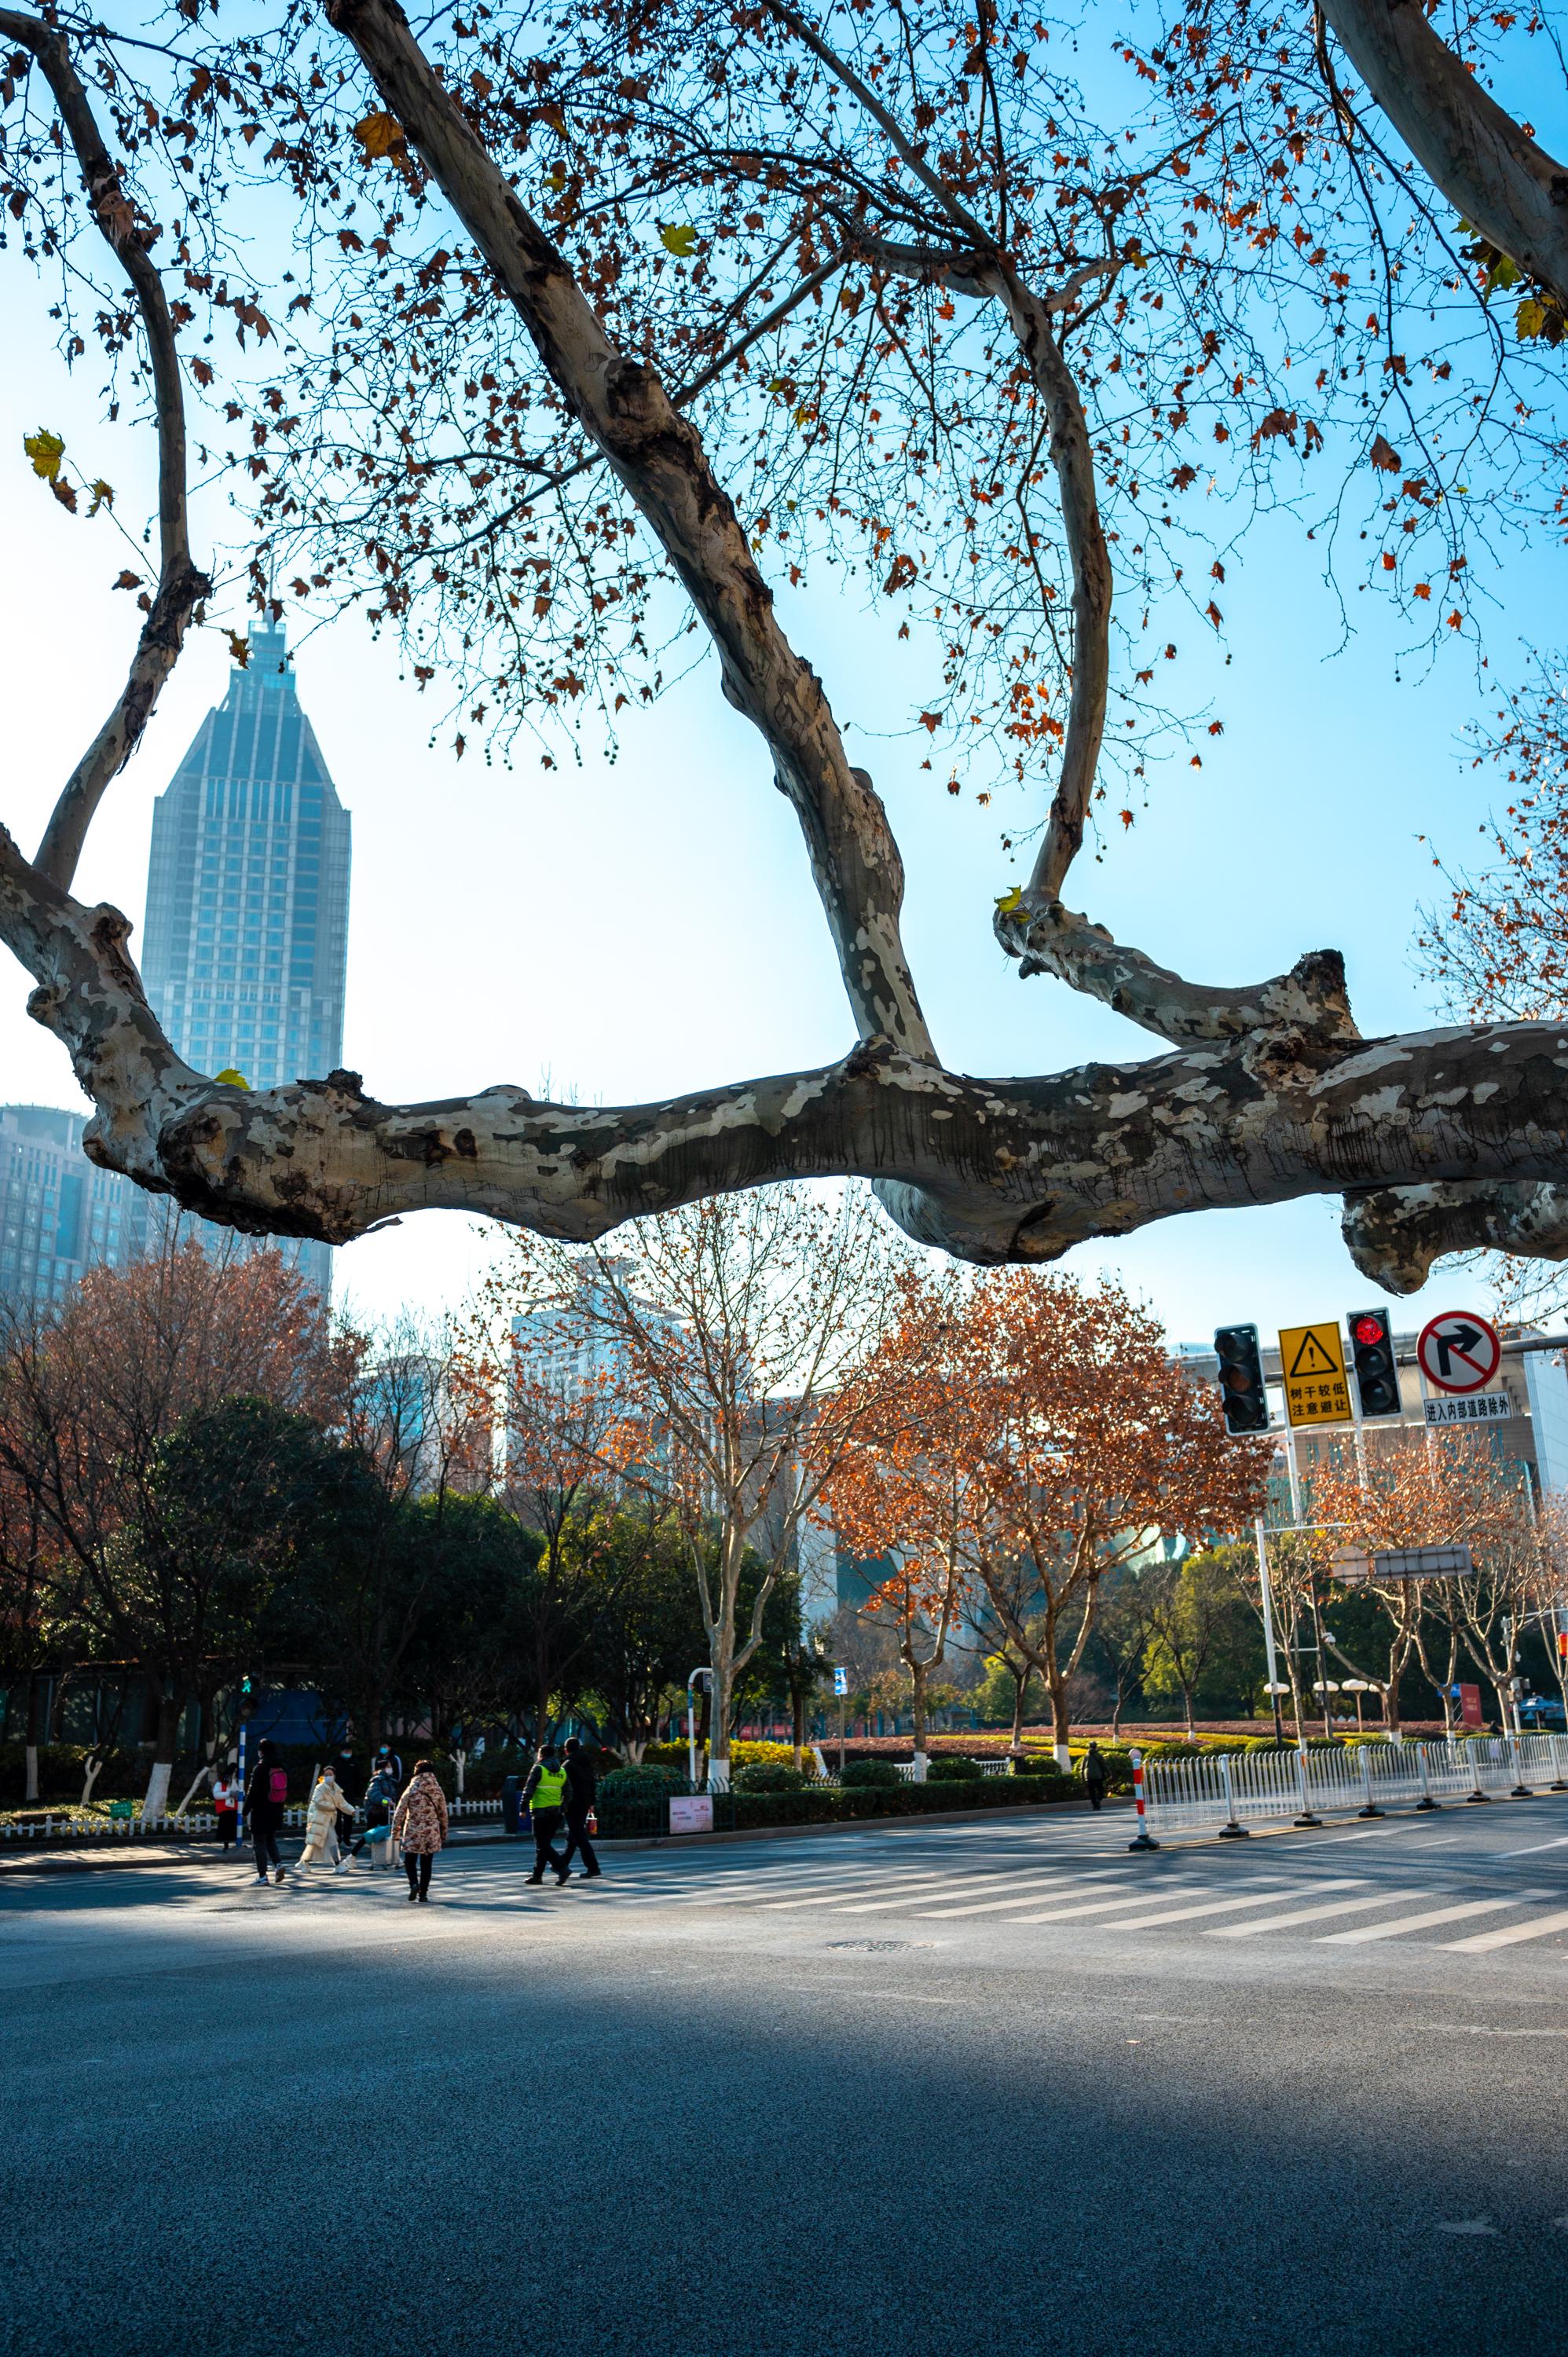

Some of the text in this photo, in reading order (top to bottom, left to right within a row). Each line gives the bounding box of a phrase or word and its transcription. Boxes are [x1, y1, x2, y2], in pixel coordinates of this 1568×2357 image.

[1291, 1383, 1345, 1399] 树干较低
[1292, 1398, 1347, 1416] 注意避让
[1427, 1396, 1508, 1421] 进入内部道路除外
